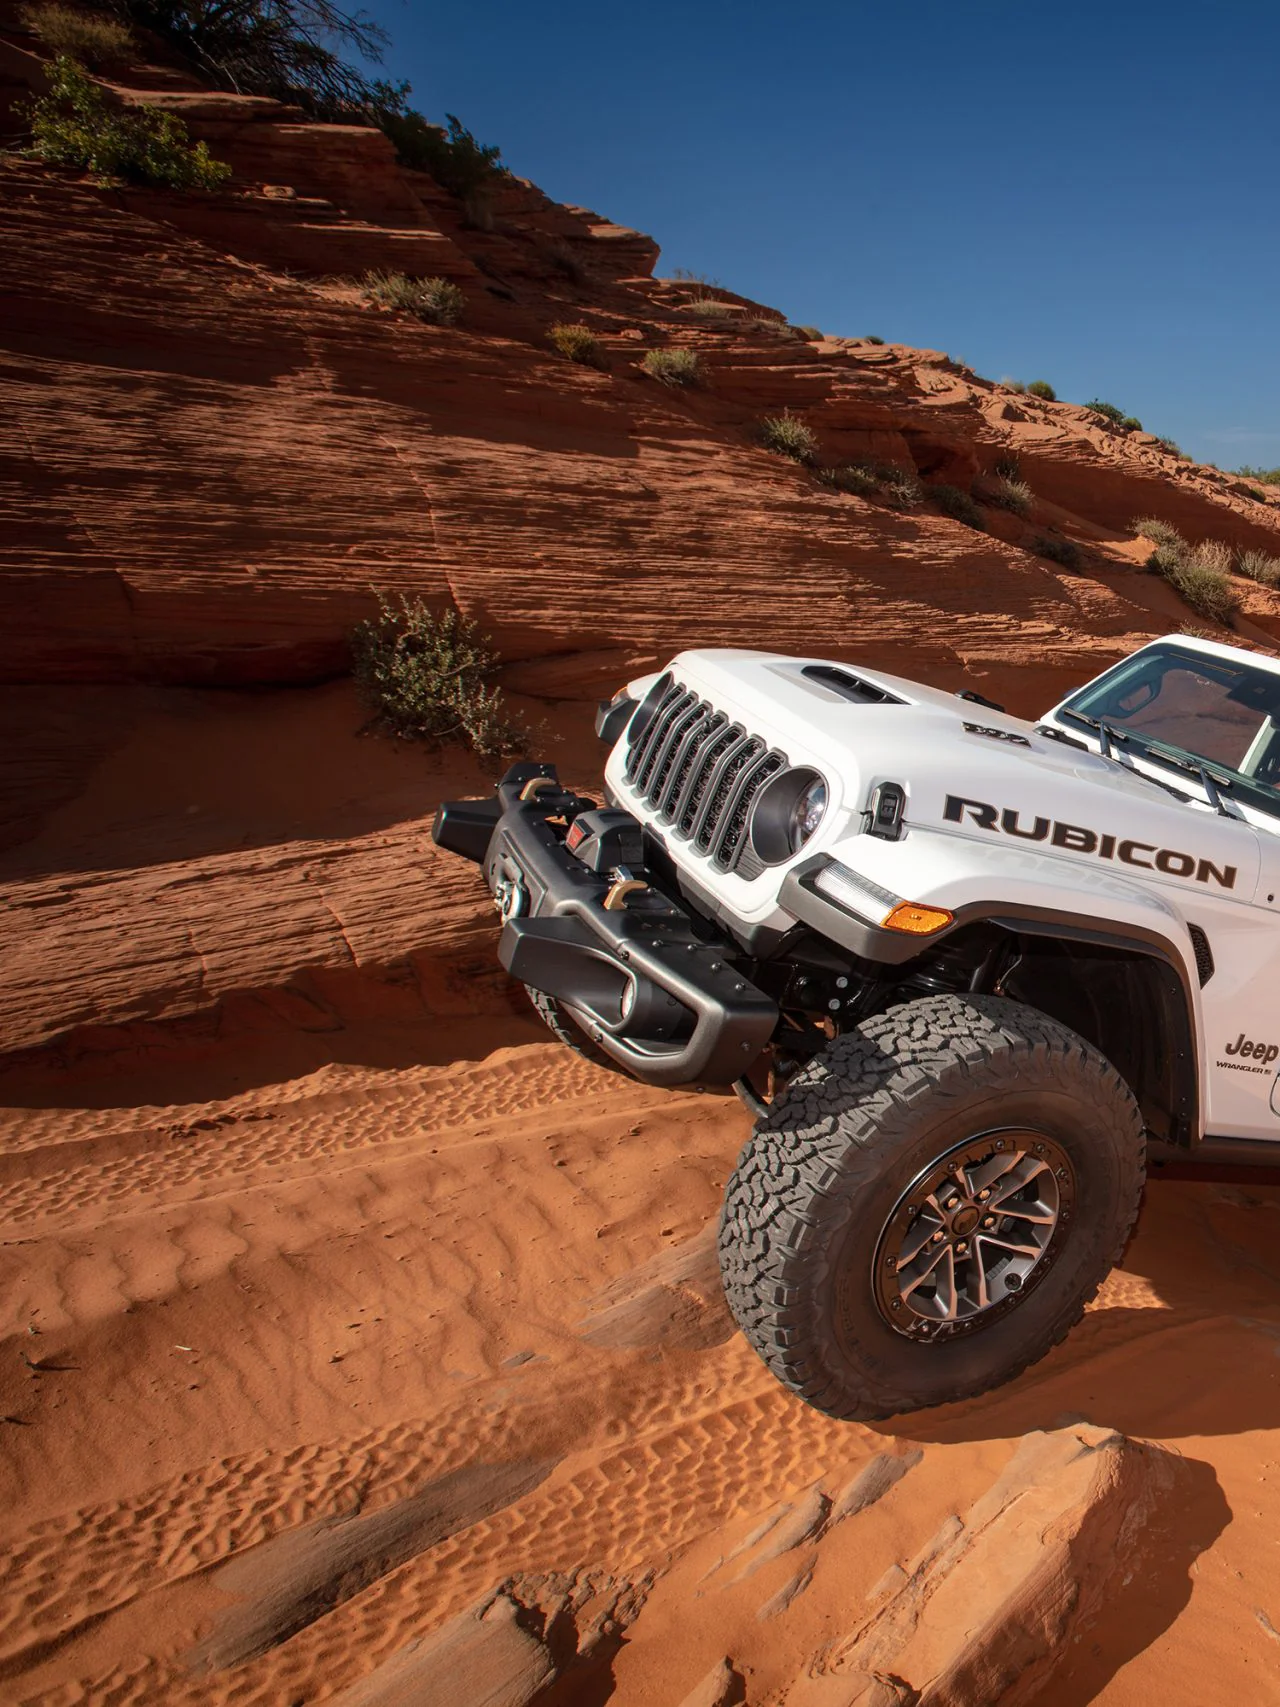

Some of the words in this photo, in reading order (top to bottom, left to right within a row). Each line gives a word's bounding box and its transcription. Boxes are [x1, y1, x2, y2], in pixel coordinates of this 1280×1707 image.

[943, 794, 1237, 889] RUBICON
[1225, 1034, 1279, 1065] Jeep
[1216, 1061, 1264, 1074] WRANGLER
